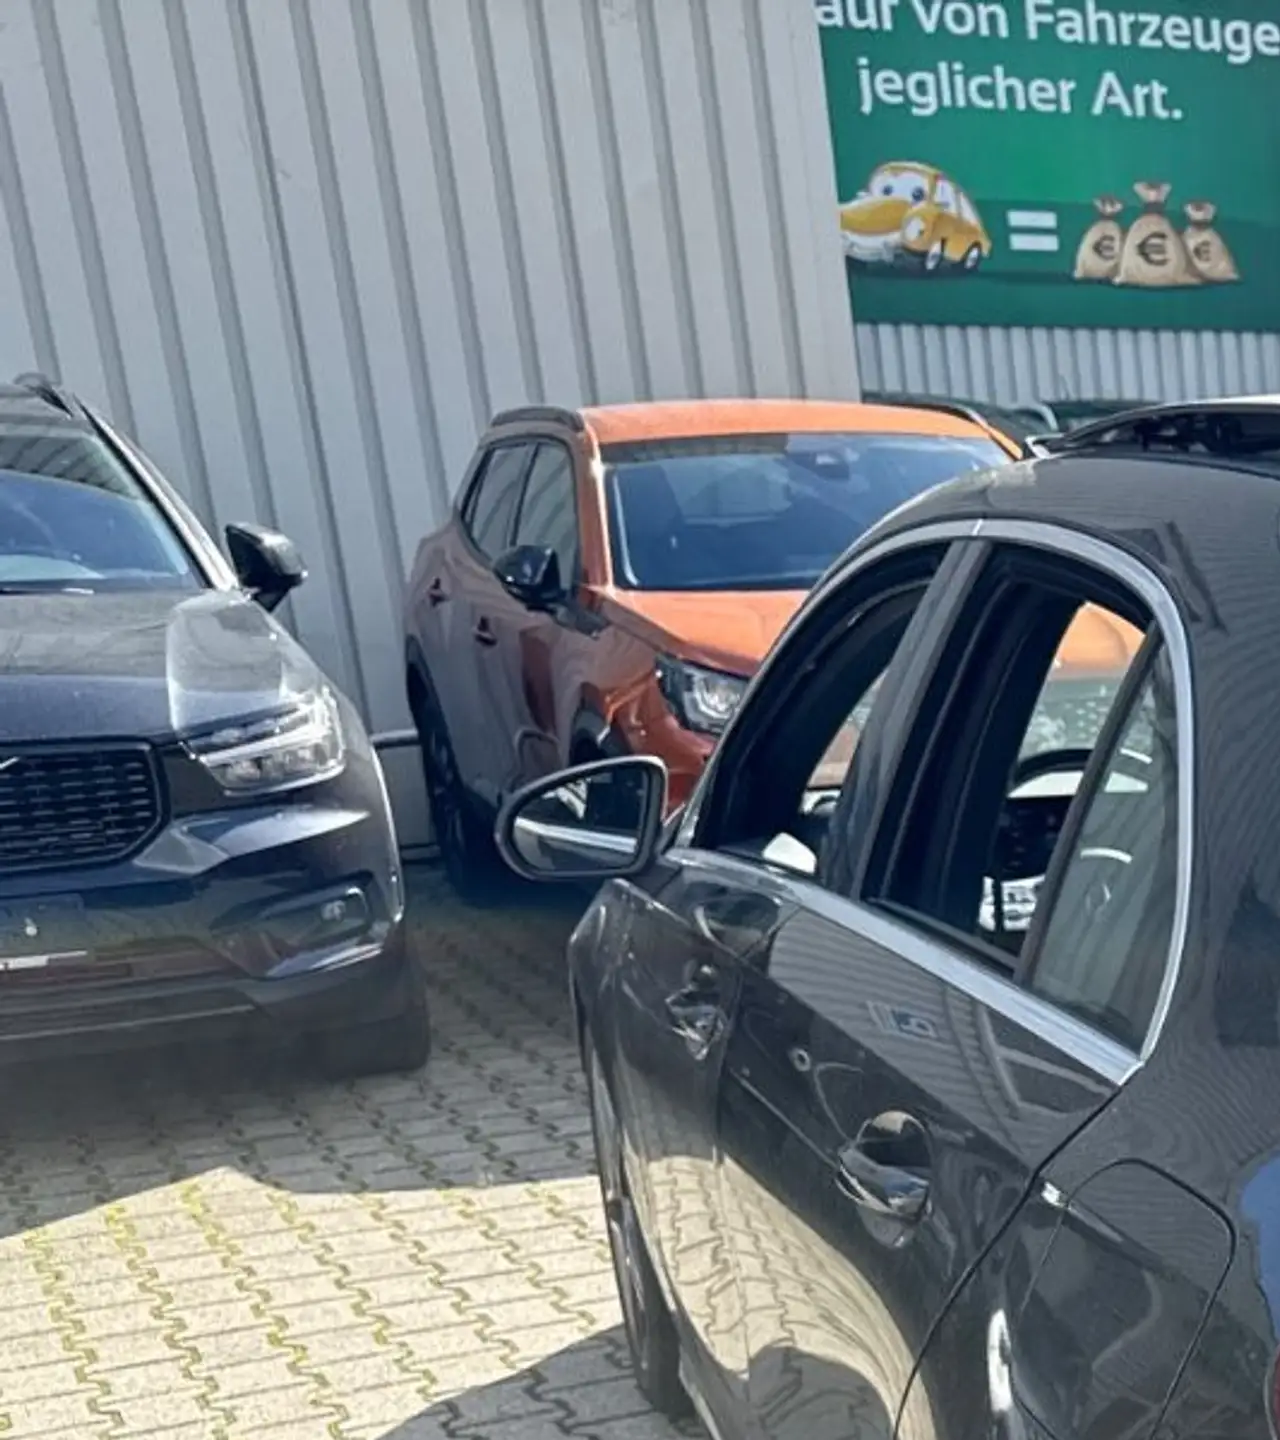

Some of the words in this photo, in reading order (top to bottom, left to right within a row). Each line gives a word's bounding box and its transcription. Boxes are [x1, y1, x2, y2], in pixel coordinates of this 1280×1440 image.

[912, 0, 1009, 38] von
[856, 56, 1077, 116] jeglicher
[1091, 70, 1184, 119] Art.
